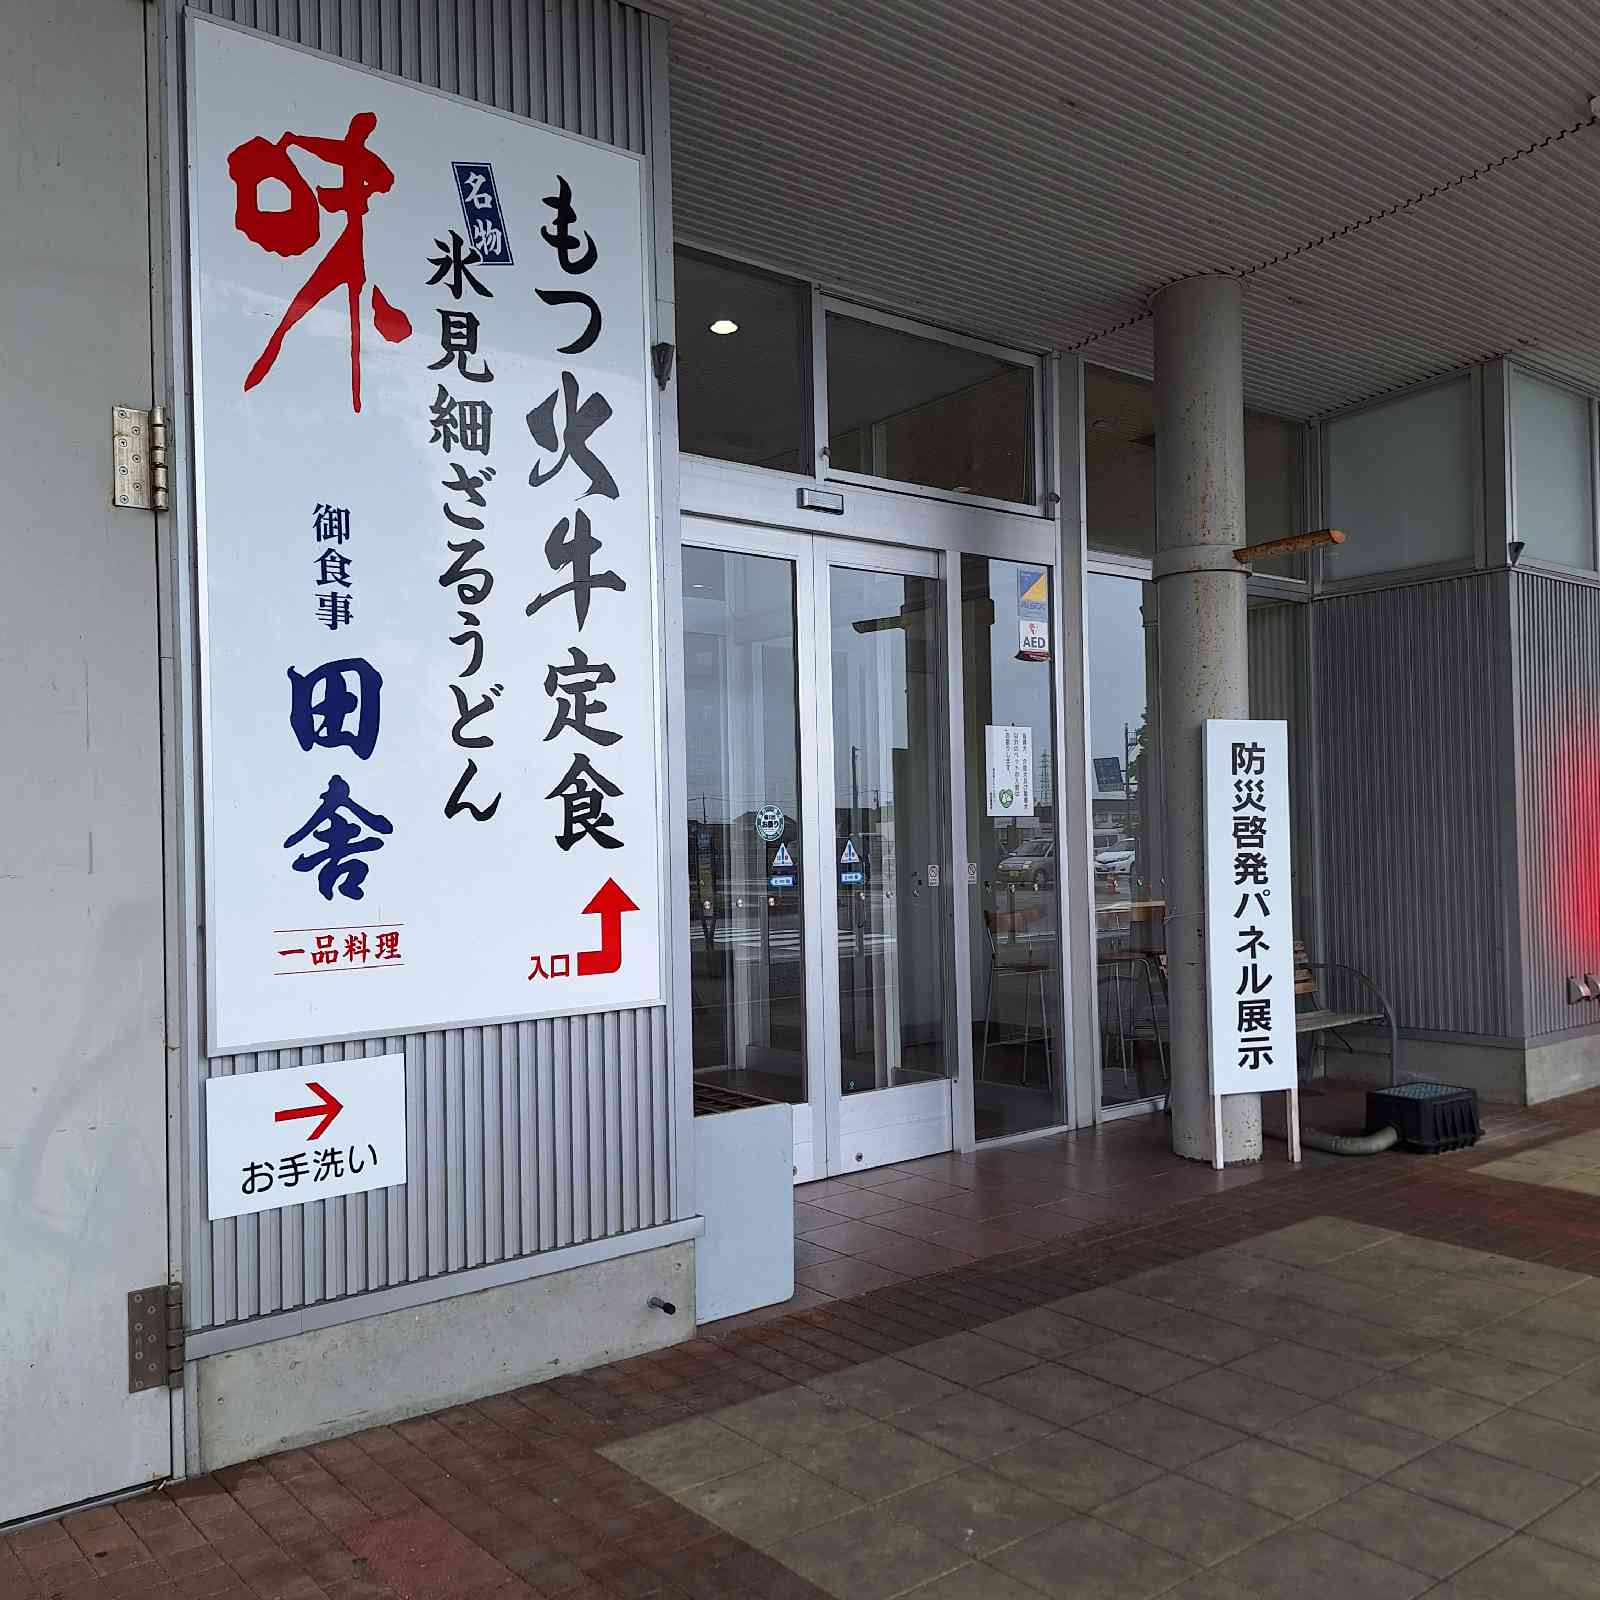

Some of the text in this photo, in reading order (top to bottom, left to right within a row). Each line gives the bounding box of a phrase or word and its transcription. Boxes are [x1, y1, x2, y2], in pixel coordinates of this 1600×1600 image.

[228, 112, 412, 413] 味
[464, 171, 503, 256] 名物
[313, 503, 353, 631] 御食事
[425, 230, 504, 821] 氷見細ざるうどん
[525, 175, 627, 851] もつ火牛定食
[1023, 636, 1046, 649] AED
[284, 657, 394, 900] 田舎
[277, 931, 402, 966] 一品料理
[527, 954, 571, 981] 入口
[1231, 742, 1273, 1070] 防災啓発パネル展示
[241, 1143, 378, 1195] お手洗い
